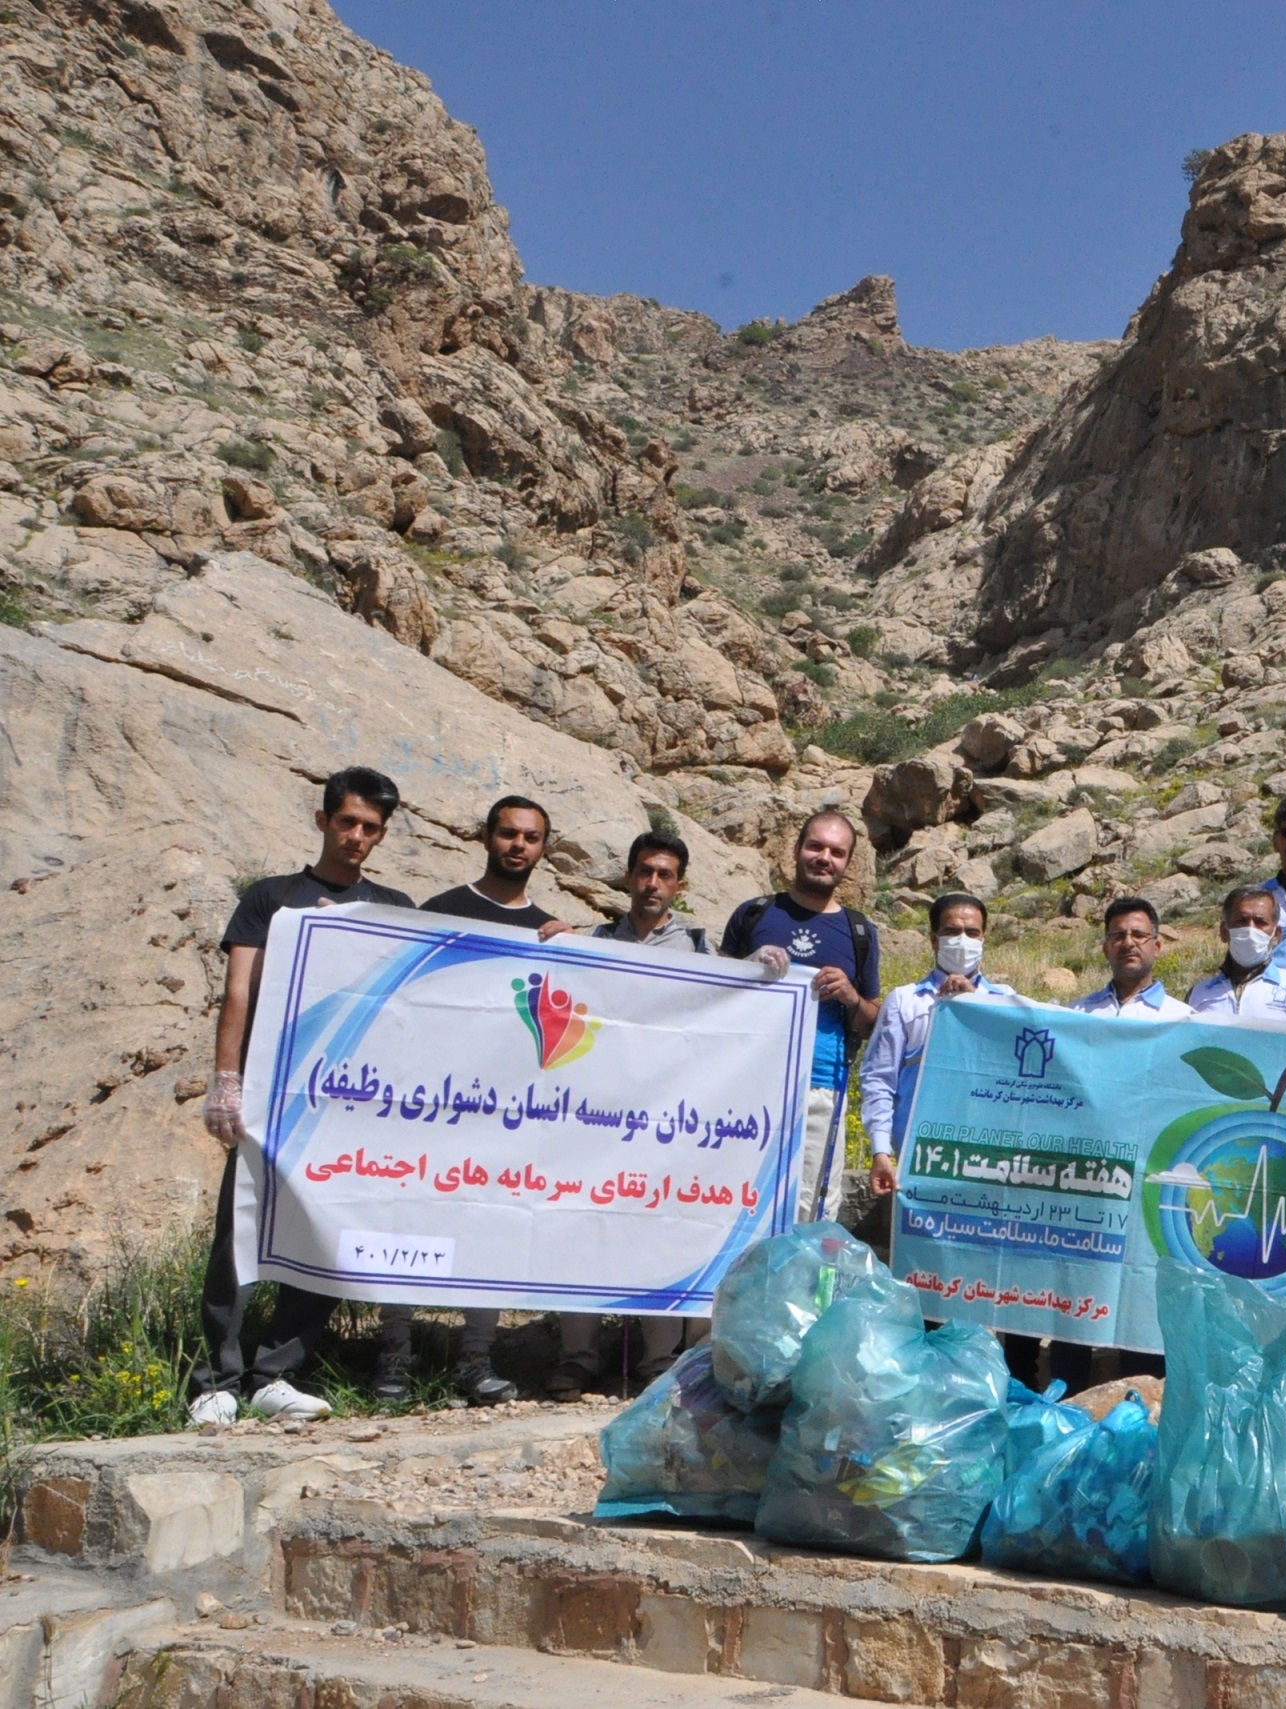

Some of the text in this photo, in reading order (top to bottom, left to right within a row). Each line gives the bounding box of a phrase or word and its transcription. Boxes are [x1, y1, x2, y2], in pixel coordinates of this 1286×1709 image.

[308, 1057, 394, 1118] وظیفه)
[399, 1073, 497, 1125] دشواری
[502, 1083, 570, 1130] انسان
[970, 1088, 1003, 1102] کرمانشاه
[1003, 1090, 1035, 1105] شهرستان
[1036, 1094, 1065, 1107] بهداشت
[575, 1097, 649, 1142] موسسه
[656, 1098, 771, 1152] (همنوردان
[918, 1120, 954, 1138] OUR
[1027, 1132, 1064, 1153] OUR
[1068, 1137, 1139, 1161] HEALTH
[305, 1147, 759, 1215] با هدف ارتقای سرمایه های اجتماعی
[915, 1143, 1133, 1199] هفته سلامت ۱۴۰۱
[906, 1186, 1129, 1230] ۱۷ تا ۲۳ اردیبهشت ماه
[908, 1209, 922, 1229] ما
[925, 1214, 976, 1240] سیاره
[977, 1220, 1037, 1244] سلامت
[1062, 1232, 1122, 1256] سلامت
[906, 1271, 1109, 1320] مرکز بهداشت شهرستان کرمانشاه
